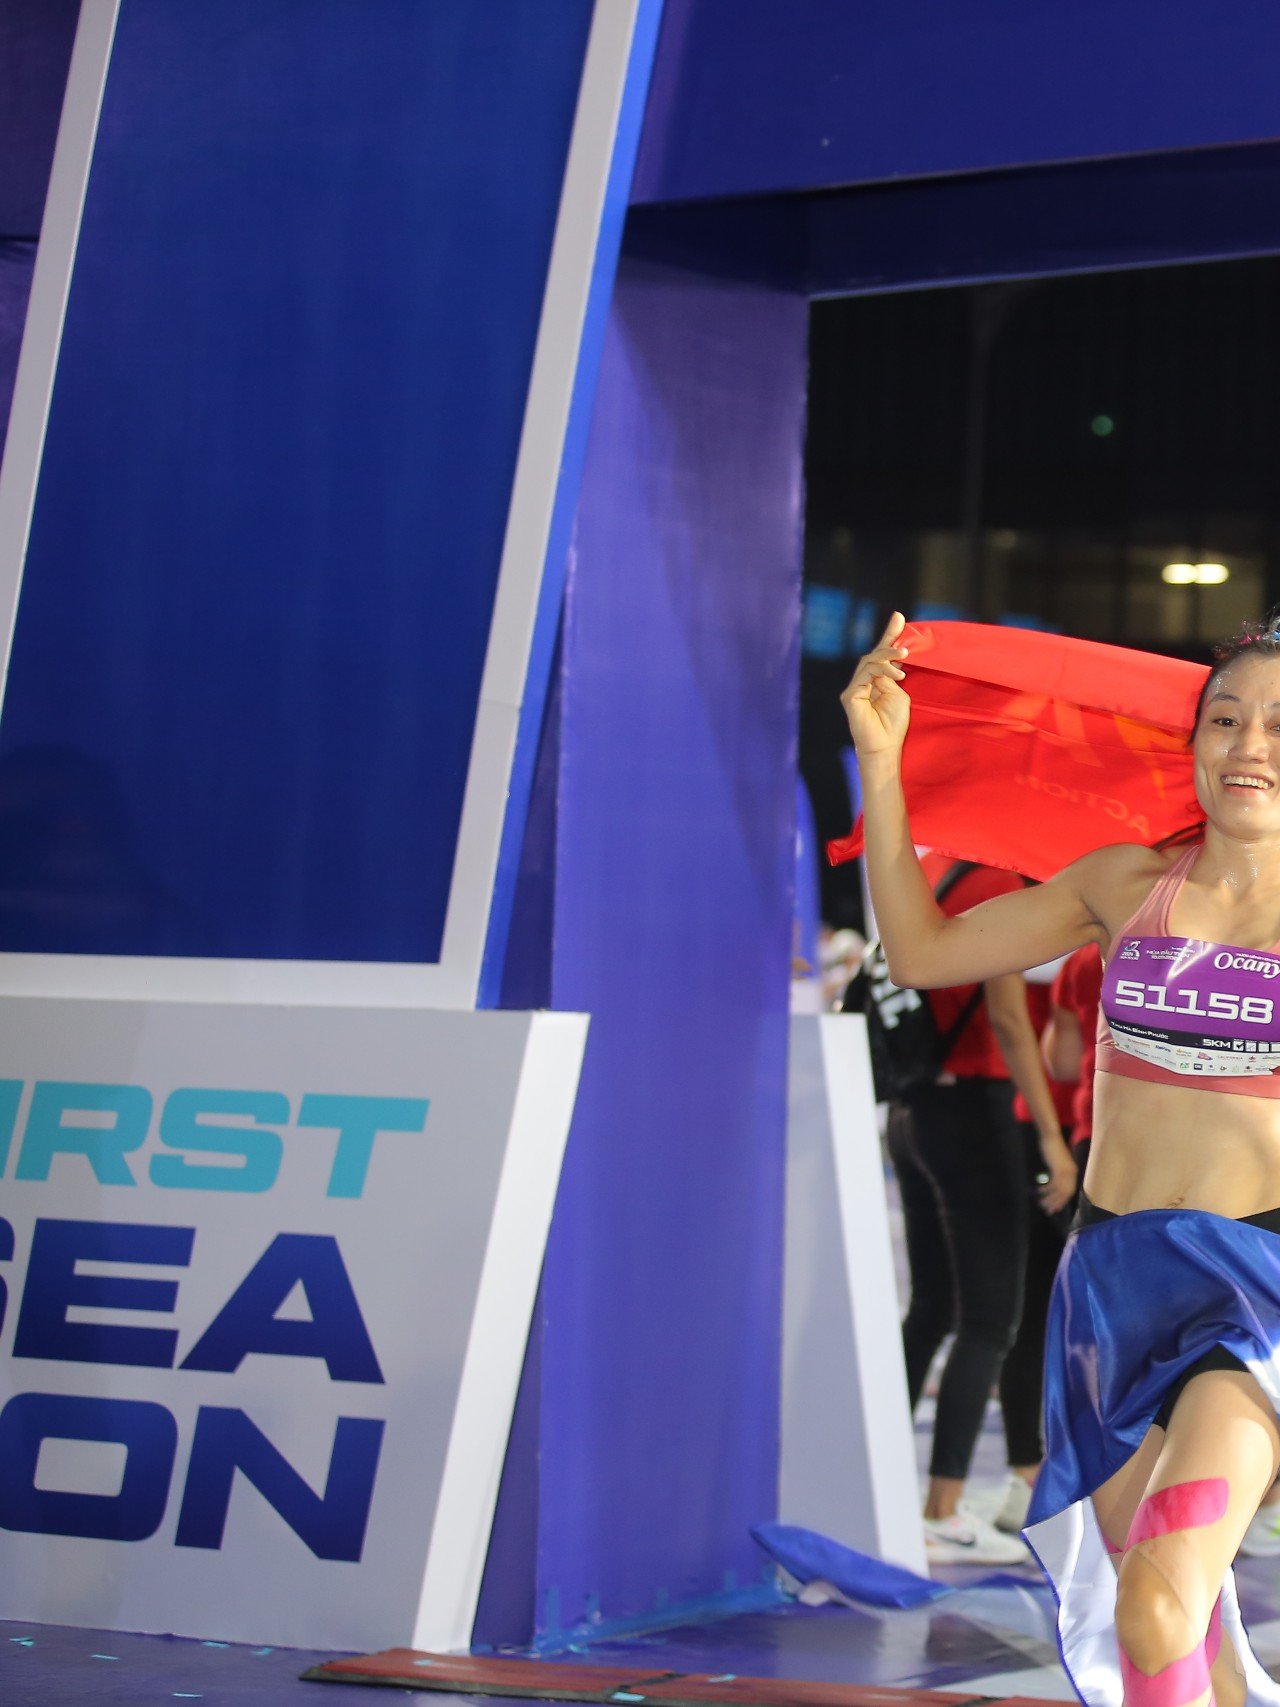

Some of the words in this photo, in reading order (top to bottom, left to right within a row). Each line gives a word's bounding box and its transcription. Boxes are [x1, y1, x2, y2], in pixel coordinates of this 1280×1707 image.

[1115, 980, 1274, 1024] 51158
[1202, 1038, 1231, 1049] 5KM
[0, 1216, 386, 1384] EA
